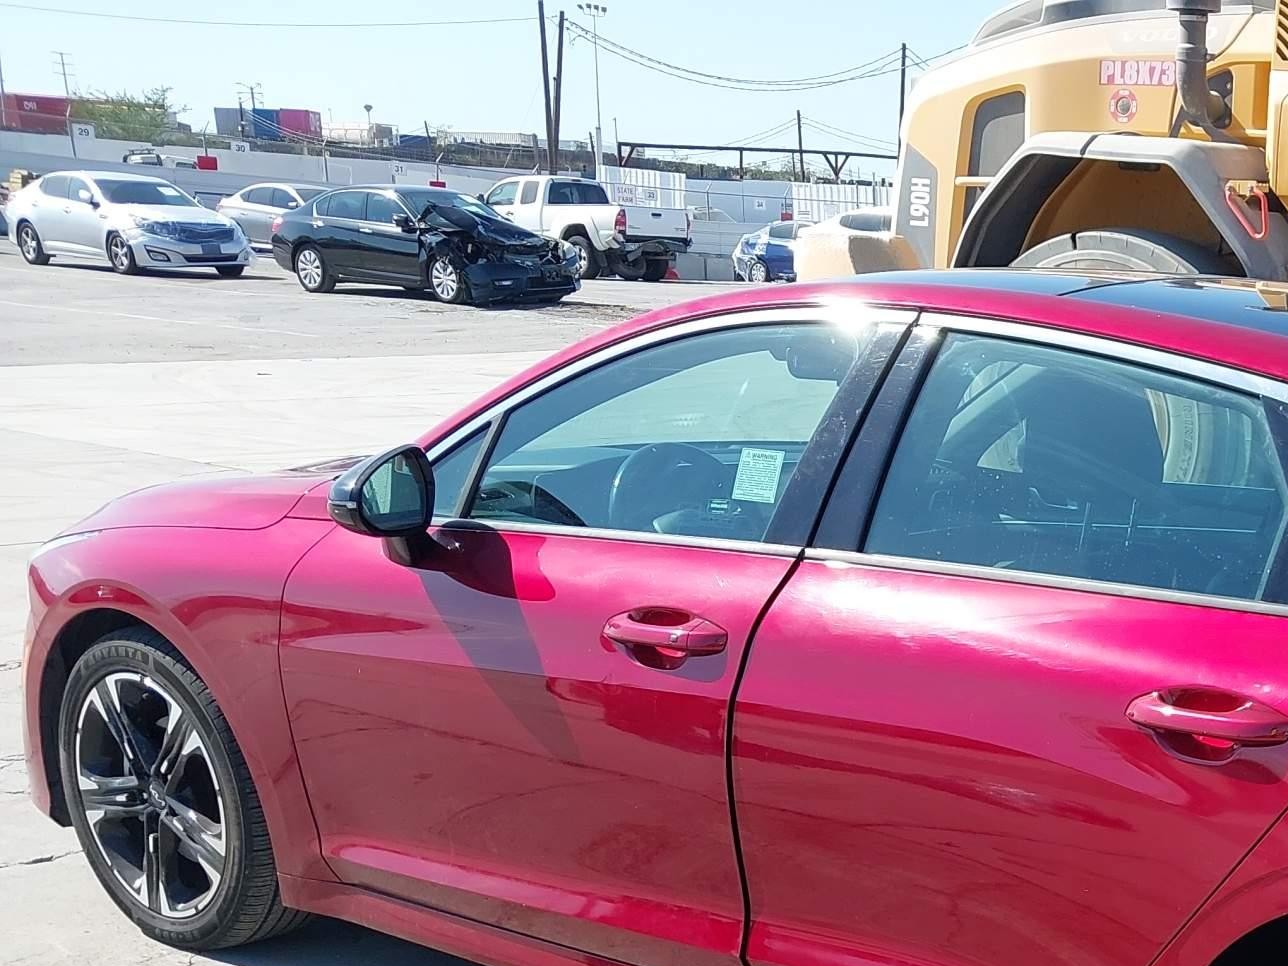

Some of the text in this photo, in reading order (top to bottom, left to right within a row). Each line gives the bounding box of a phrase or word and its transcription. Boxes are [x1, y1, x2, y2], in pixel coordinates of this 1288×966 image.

[1100, 60, 1175, 85] PL8X73
[78, 127, 89, 136] 29
[235, 144, 245, 152] 30
[394, 165, 403, 173] 31
[910, 177, 930, 226] L90H
